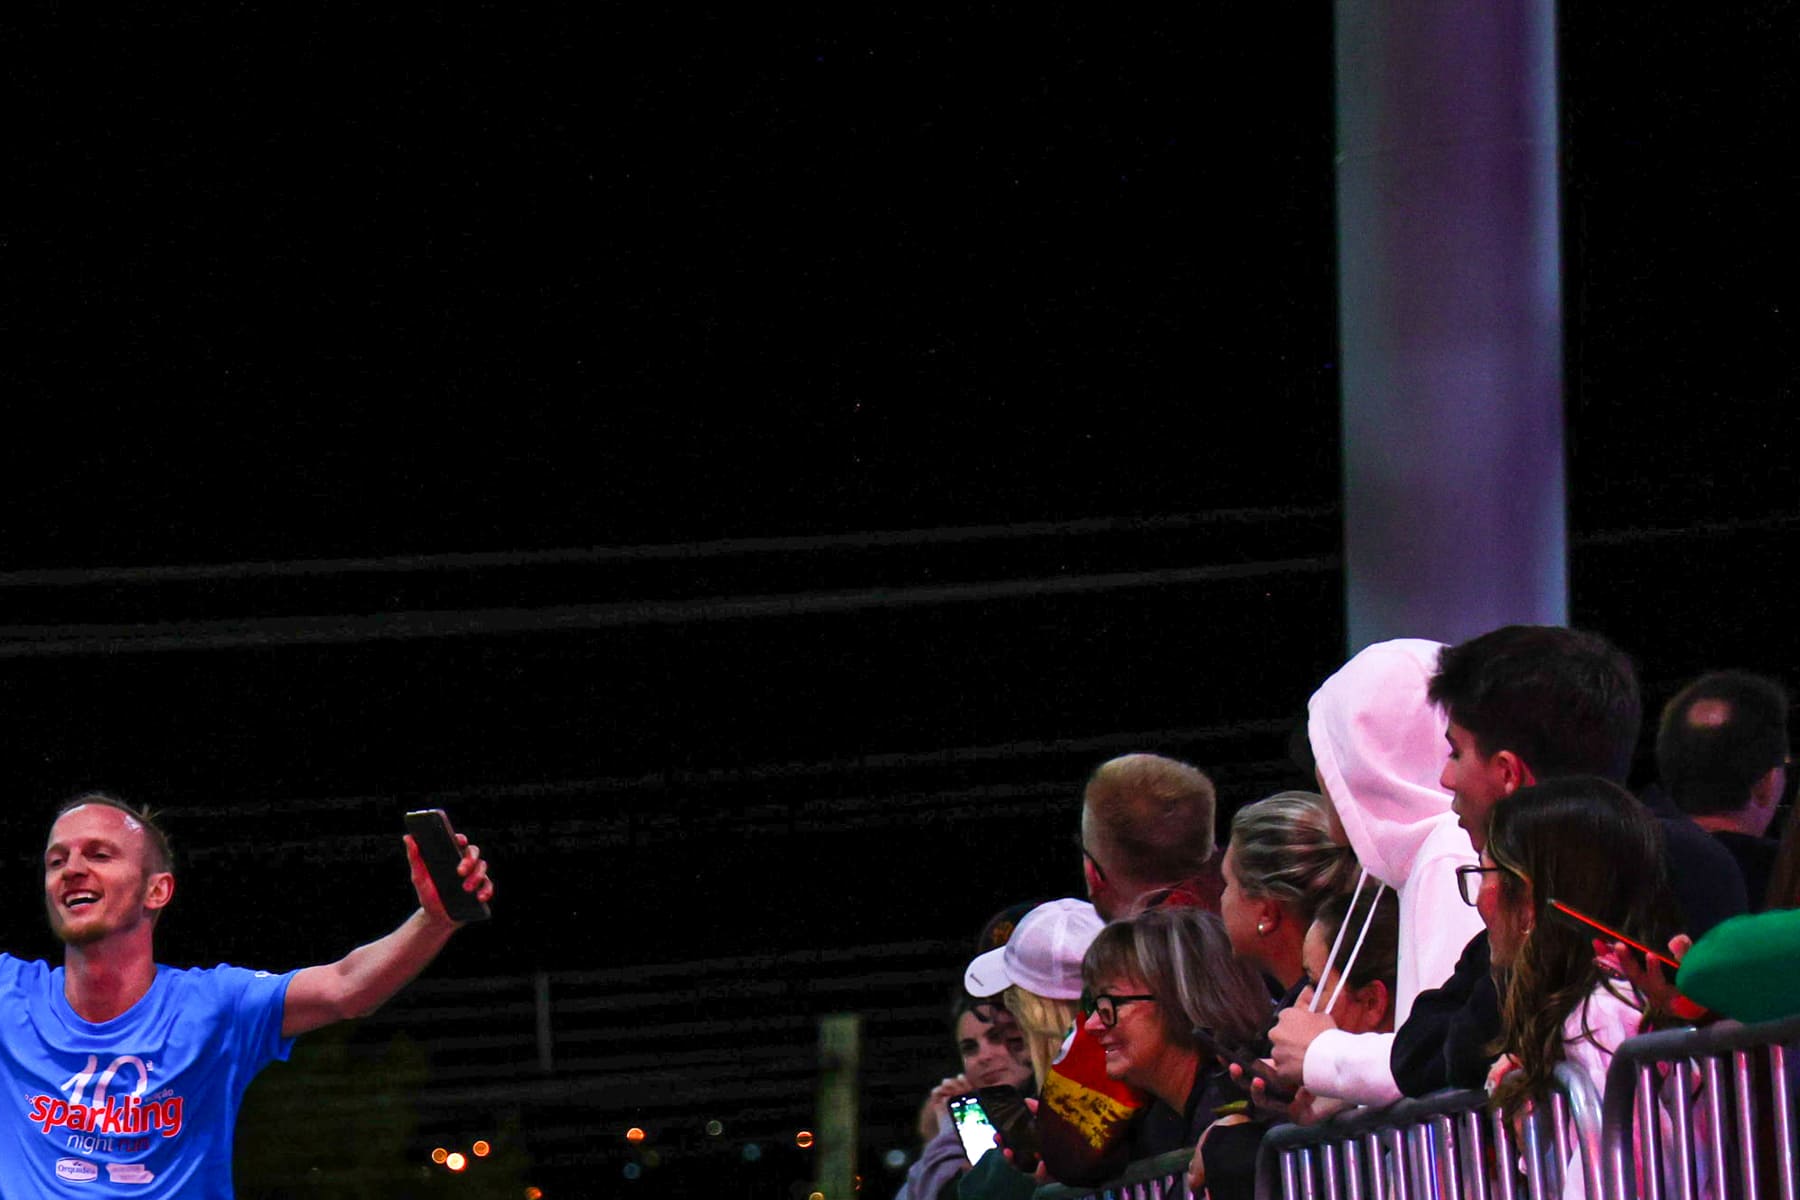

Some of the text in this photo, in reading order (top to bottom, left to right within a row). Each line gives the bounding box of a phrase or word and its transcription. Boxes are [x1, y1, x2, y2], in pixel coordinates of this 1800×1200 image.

[28, 1093, 184, 1138] sparkling
[66, 1134, 150, 1155] night run
